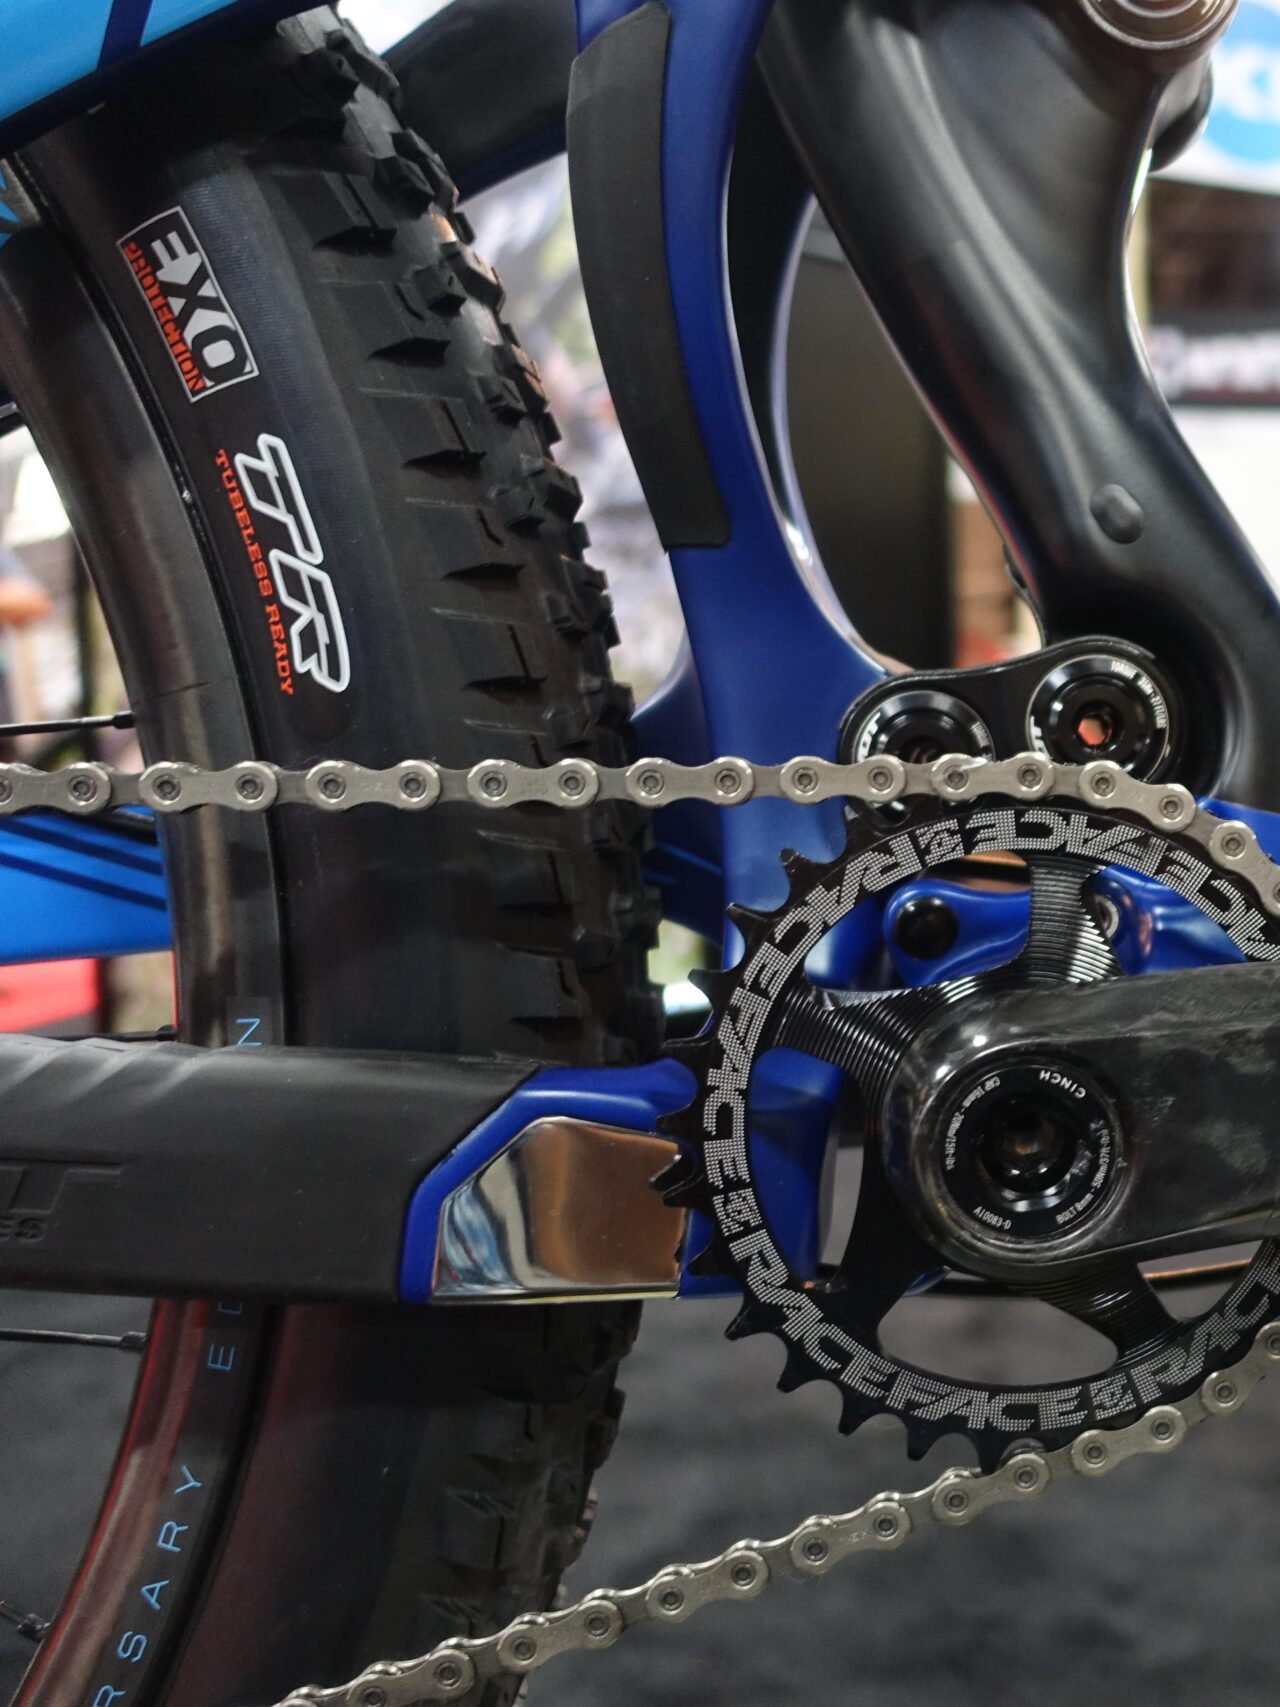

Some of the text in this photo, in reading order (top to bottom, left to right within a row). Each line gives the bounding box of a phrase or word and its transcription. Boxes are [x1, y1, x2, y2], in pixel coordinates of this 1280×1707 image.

[123, 241, 206, 392] PROTECTION
[151, 230, 250, 385] EXO
[214, 448, 294, 696] TUBELESS READY
[235, 432, 350, 693] TR
[985, 1075, 1001, 1092] CAP
[1039, 1069, 1087, 1100] CINCH
